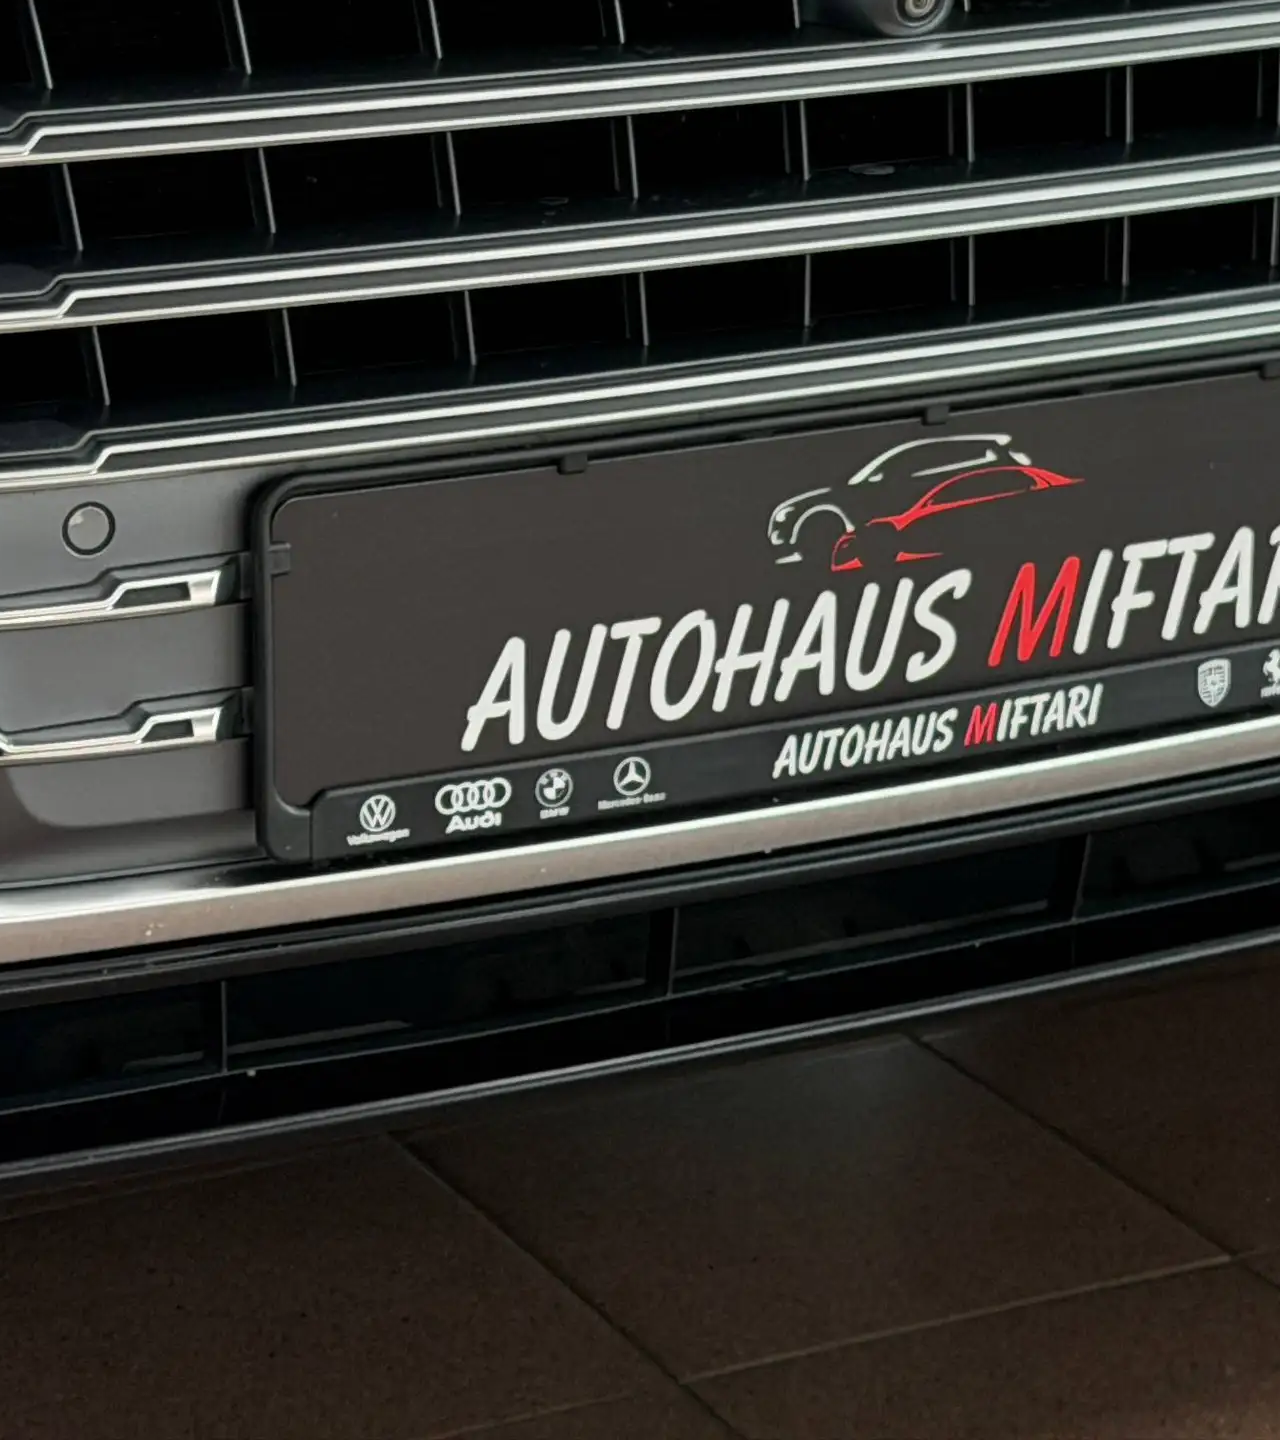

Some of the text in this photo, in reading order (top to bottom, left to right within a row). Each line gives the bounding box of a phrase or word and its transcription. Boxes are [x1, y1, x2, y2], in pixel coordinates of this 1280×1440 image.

[460, 568, 973, 752] AUTOHAUS
[772, 683, 1104, 779] AUTOHAUS MIFTARI
[445, 811, 503, 835] Audi
